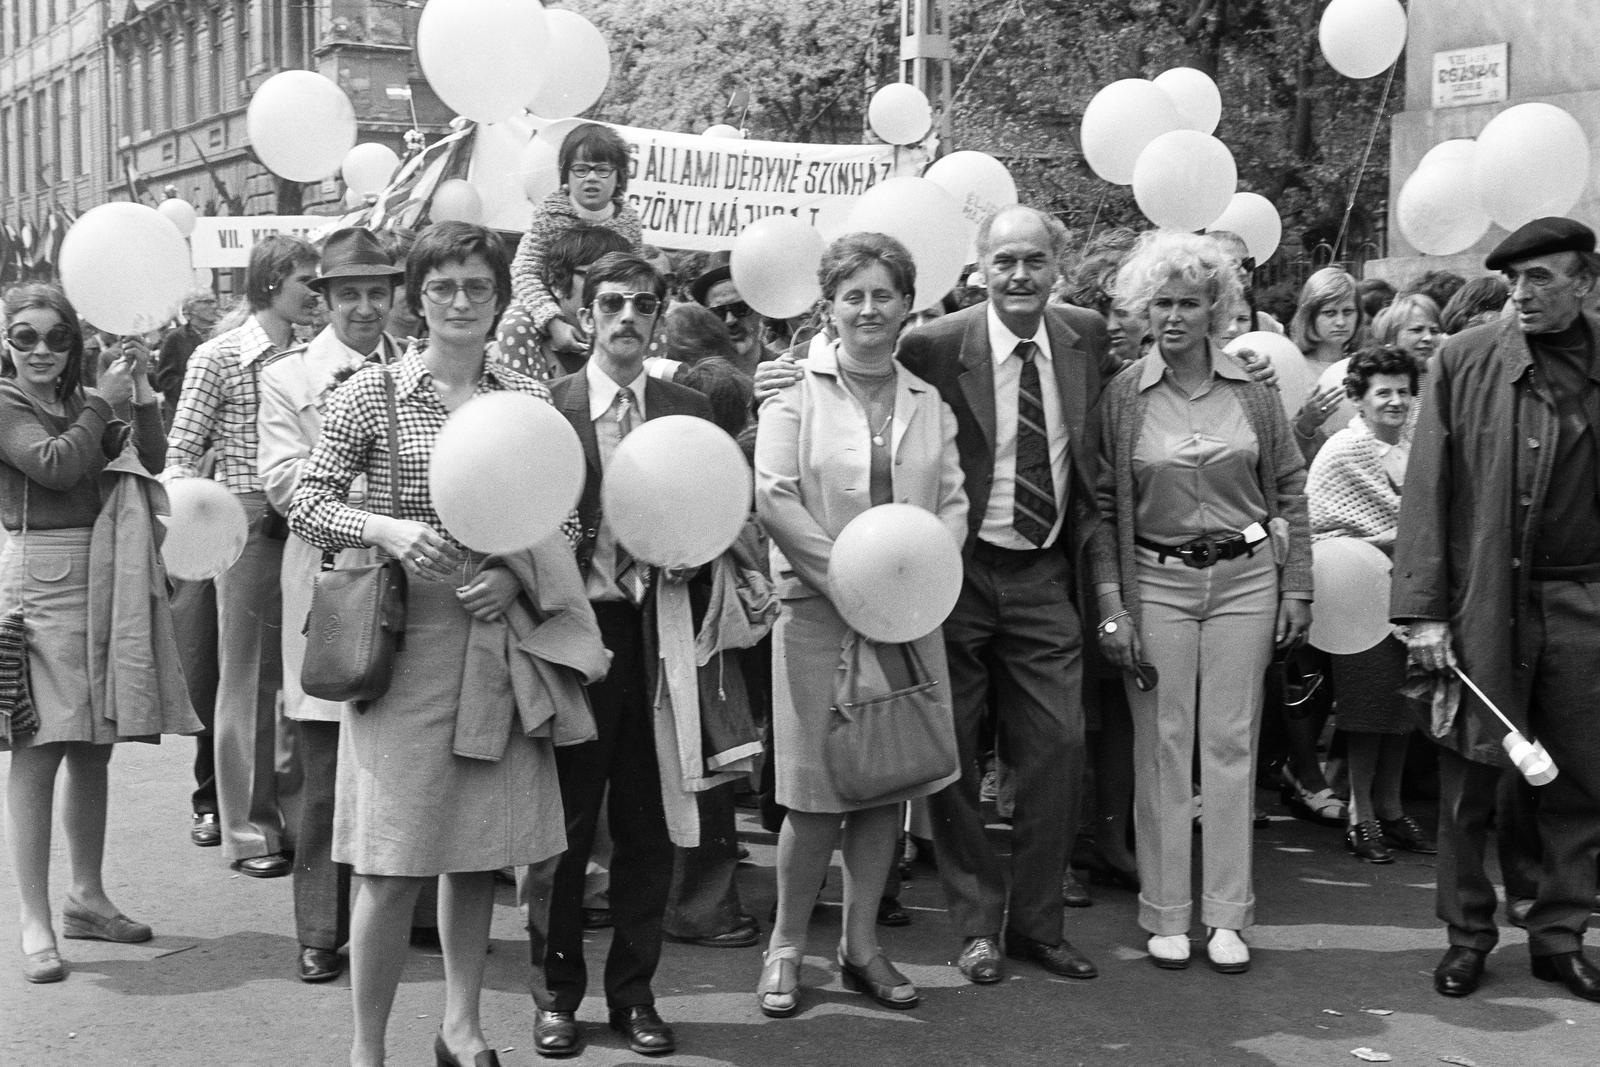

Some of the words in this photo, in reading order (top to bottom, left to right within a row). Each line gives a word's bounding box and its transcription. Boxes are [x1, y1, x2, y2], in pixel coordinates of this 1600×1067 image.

[644, 138, 721, 189] ÁLLAMI
[723, 148, 802, 194] DÉRYNÉ
[804, 156, 892, 196] SZINHÁZ
[706, 196, 785, 237] MÁJ
[217, 228, 244, 249] VII.
